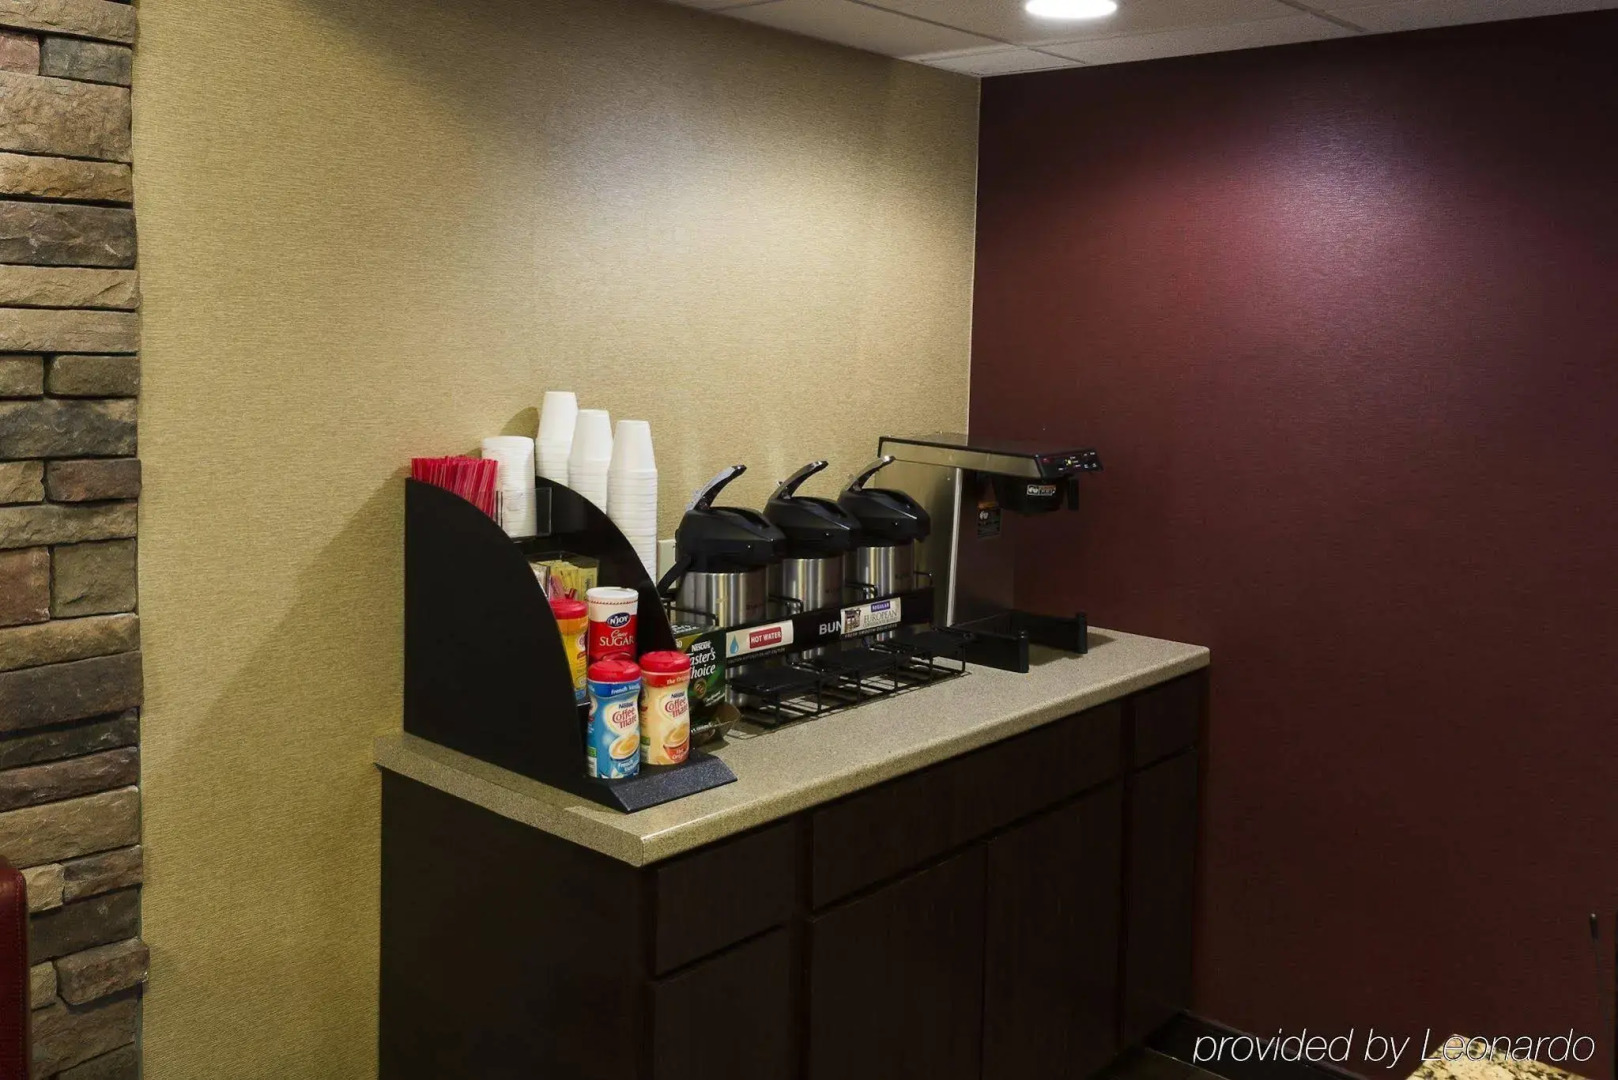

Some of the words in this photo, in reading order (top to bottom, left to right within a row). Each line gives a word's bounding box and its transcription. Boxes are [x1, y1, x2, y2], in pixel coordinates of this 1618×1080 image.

[863, 609, 898, 624] EUROPEAN
[600, 636, 634, 646] SUGAR
[750, 635, 763, 645] HOT
[763, 630, 782, 641] WATER
[690, 647, 716, 666] aster's
[690, 664, 716, 680] hoice
[665, 697, 686, 713] Coffee
[612, 708, 634, 724] Coffee
[620, 715, 637, 729] mate
